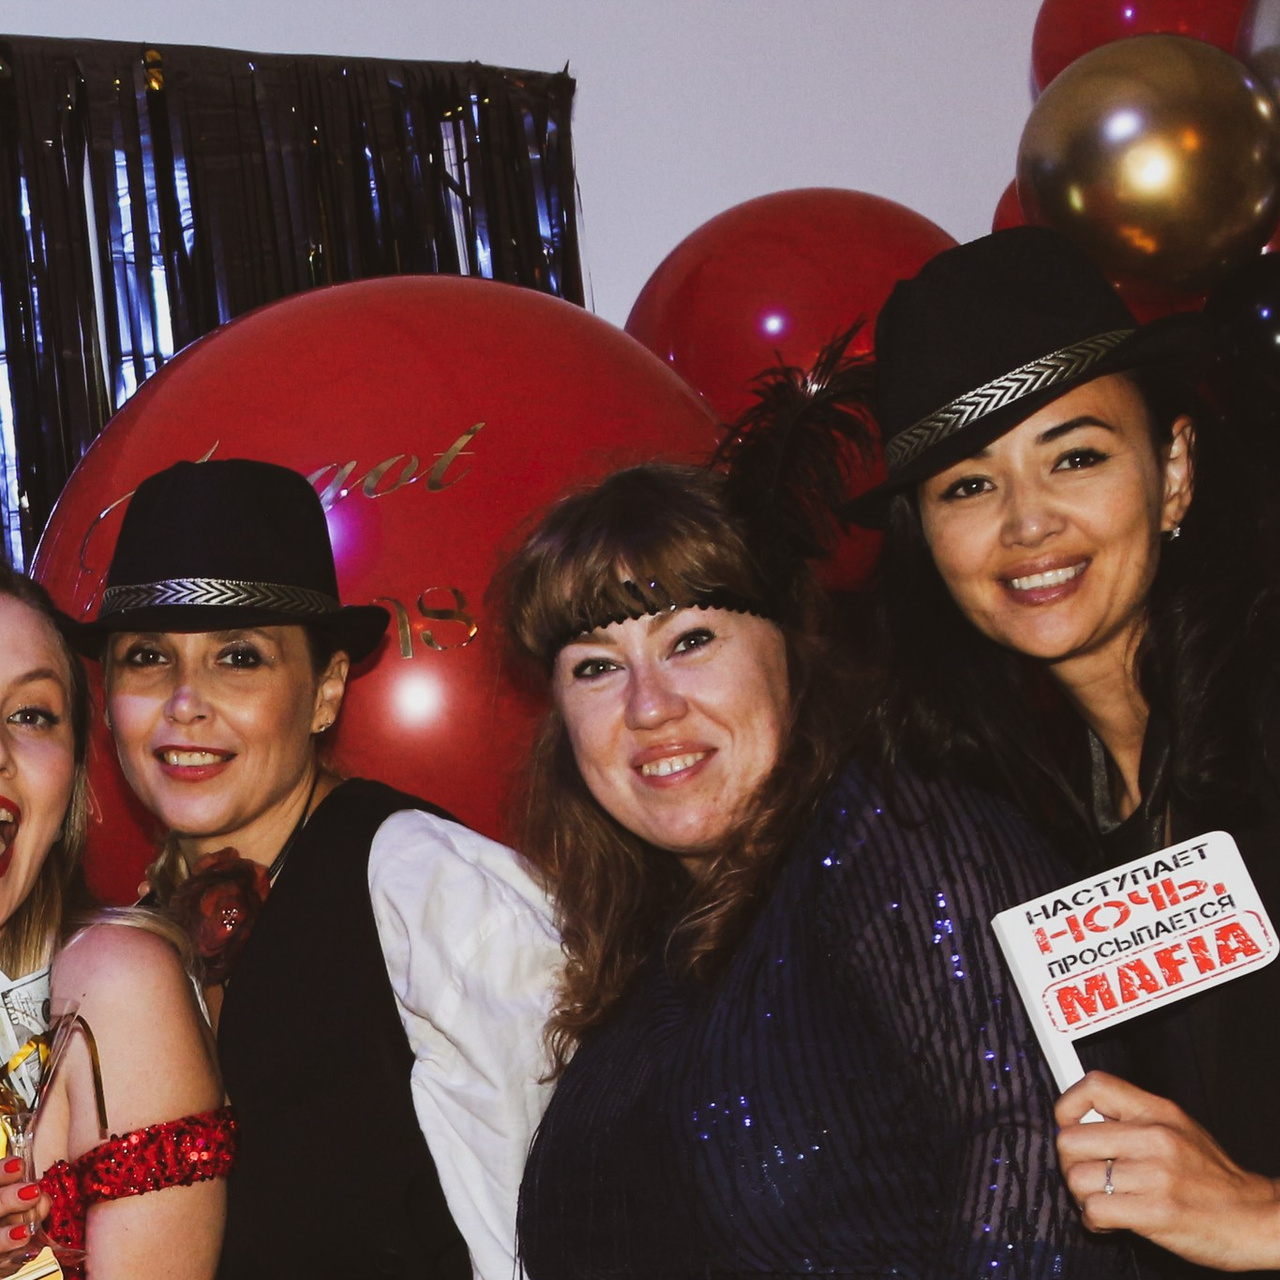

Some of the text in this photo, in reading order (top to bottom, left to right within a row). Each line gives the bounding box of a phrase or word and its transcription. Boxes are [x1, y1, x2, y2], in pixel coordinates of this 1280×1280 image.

[1025, 843, 1208, 925] НАСТУПАЕТ
[1032, 877, 1226, 955] НОЧЬ,
[1046, 894, 1237, 979] ПРОСЫПАЕТСЯ
[1054, 921, 1263, 1026] MAFIA
